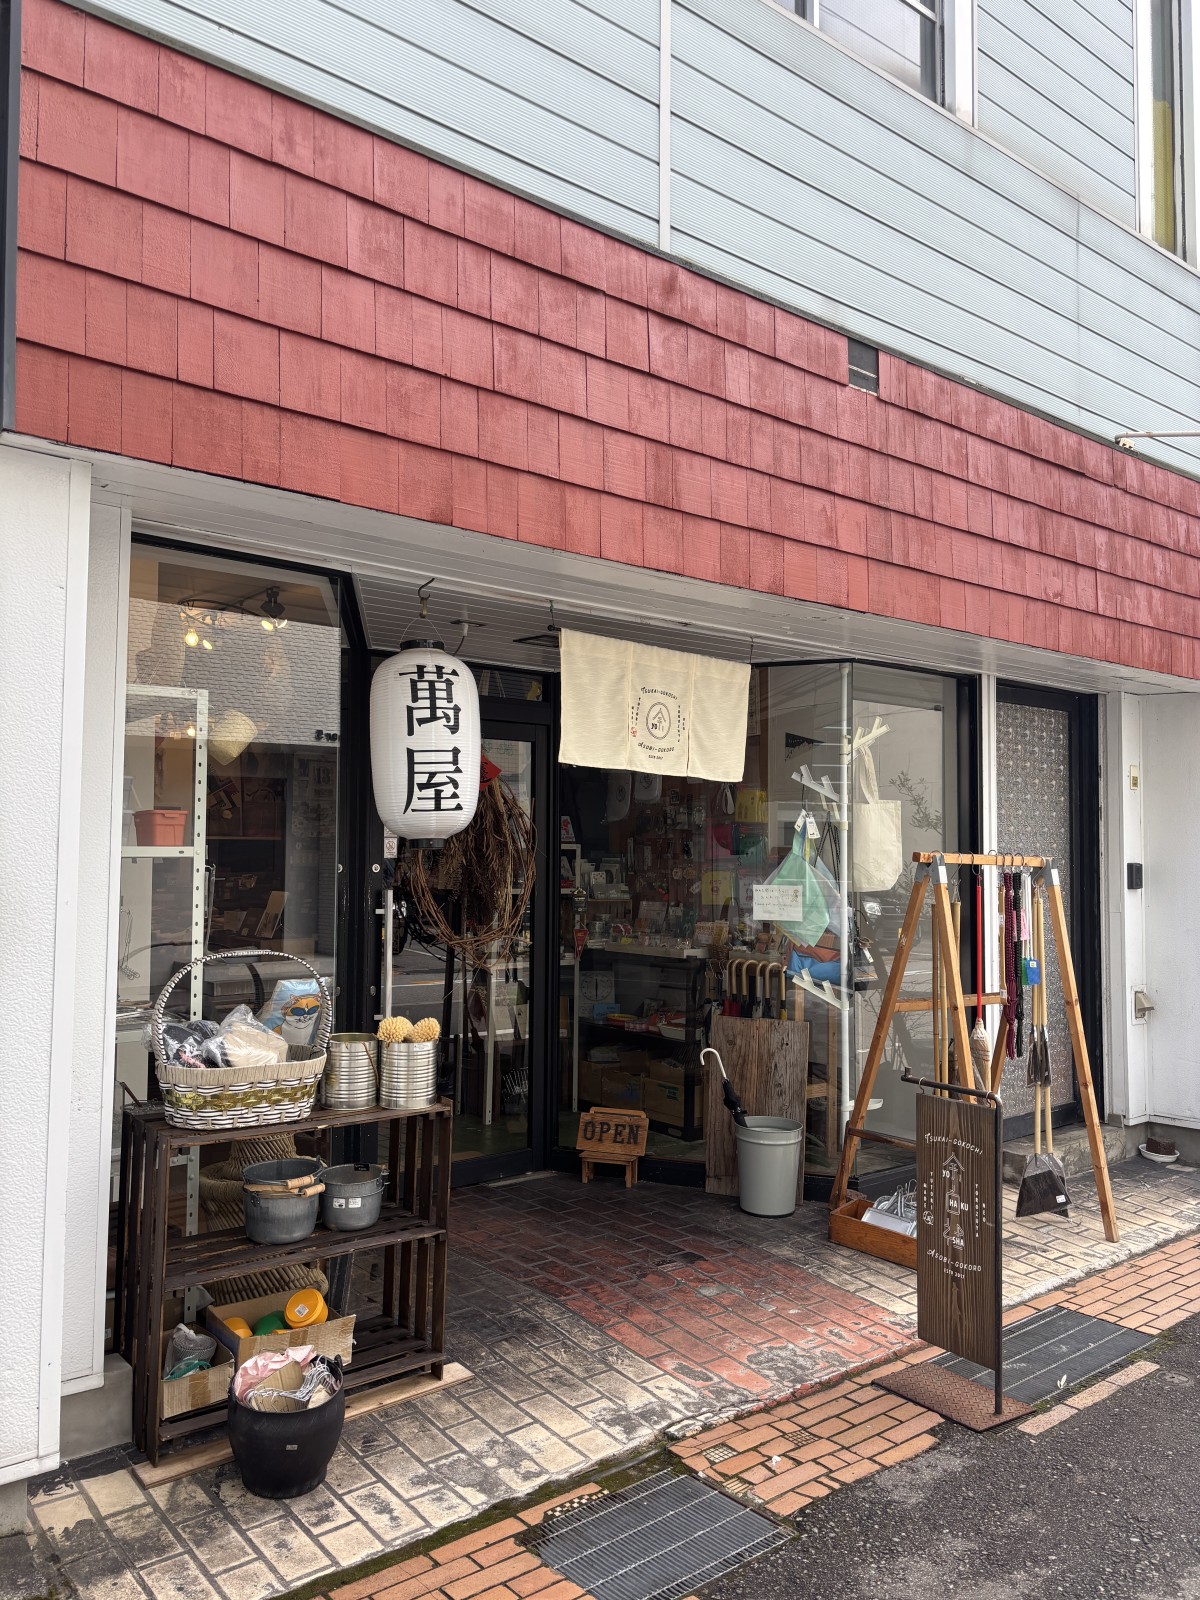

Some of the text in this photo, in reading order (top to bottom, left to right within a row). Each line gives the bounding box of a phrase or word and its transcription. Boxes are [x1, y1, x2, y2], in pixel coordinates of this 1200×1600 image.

[399, 665, 464, 814] 萬屋
[583, 1121, 640, 1144] OPEN
[925, 1133, 983, 1155] TSUKAI-GOKOCHI
[927, 1249, 982, 1272] ASOBI-GOKORO
